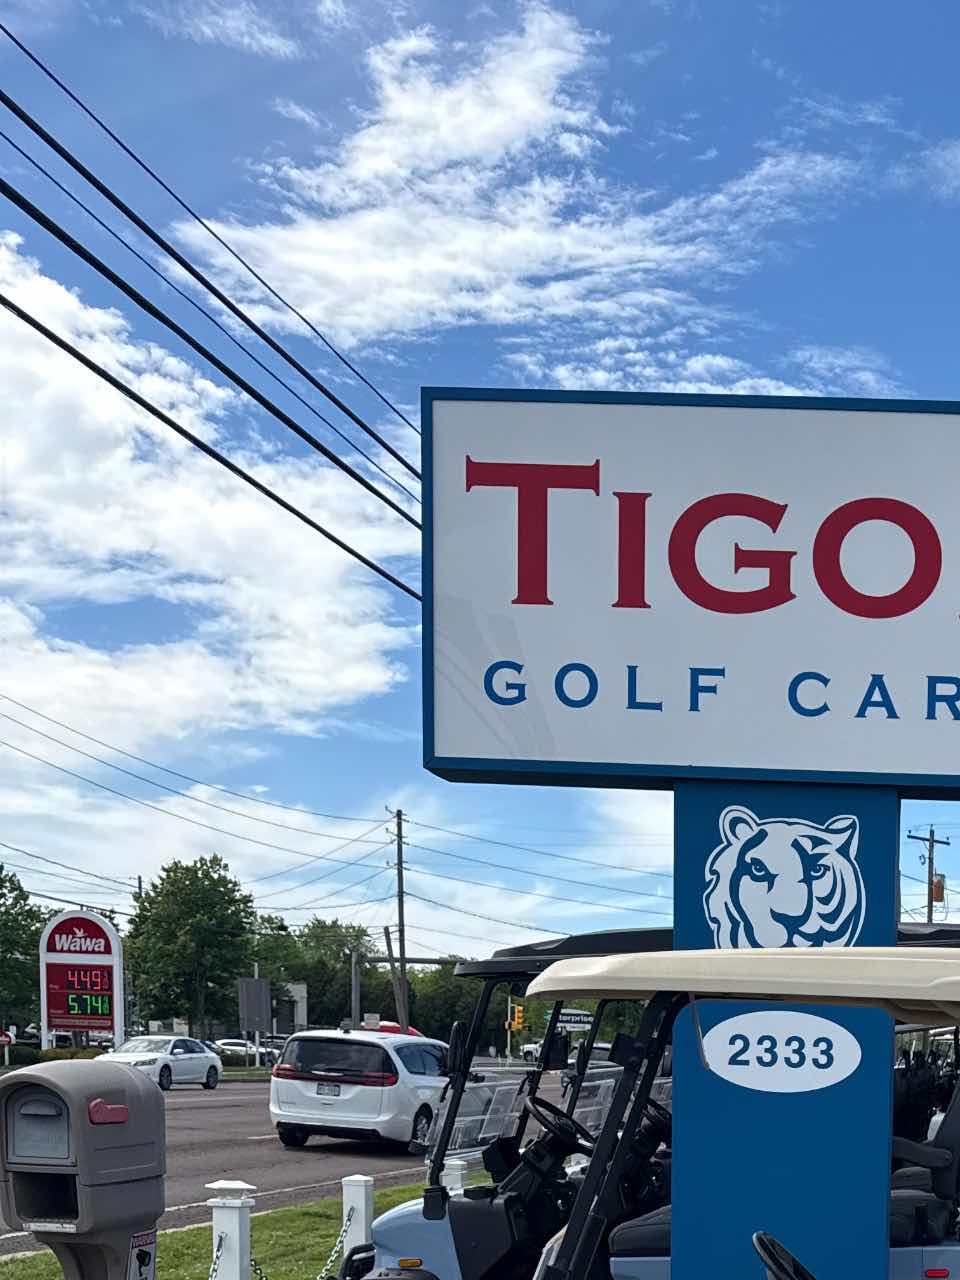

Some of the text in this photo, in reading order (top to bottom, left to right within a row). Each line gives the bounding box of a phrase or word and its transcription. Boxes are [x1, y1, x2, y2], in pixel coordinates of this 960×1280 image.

[483, 660, 726, 712] GOLF
[55, 934, 105, 952] Wawa
[559, 1014, 594, 1023] terprise
[727, 1033, 835, 1070] 2333
